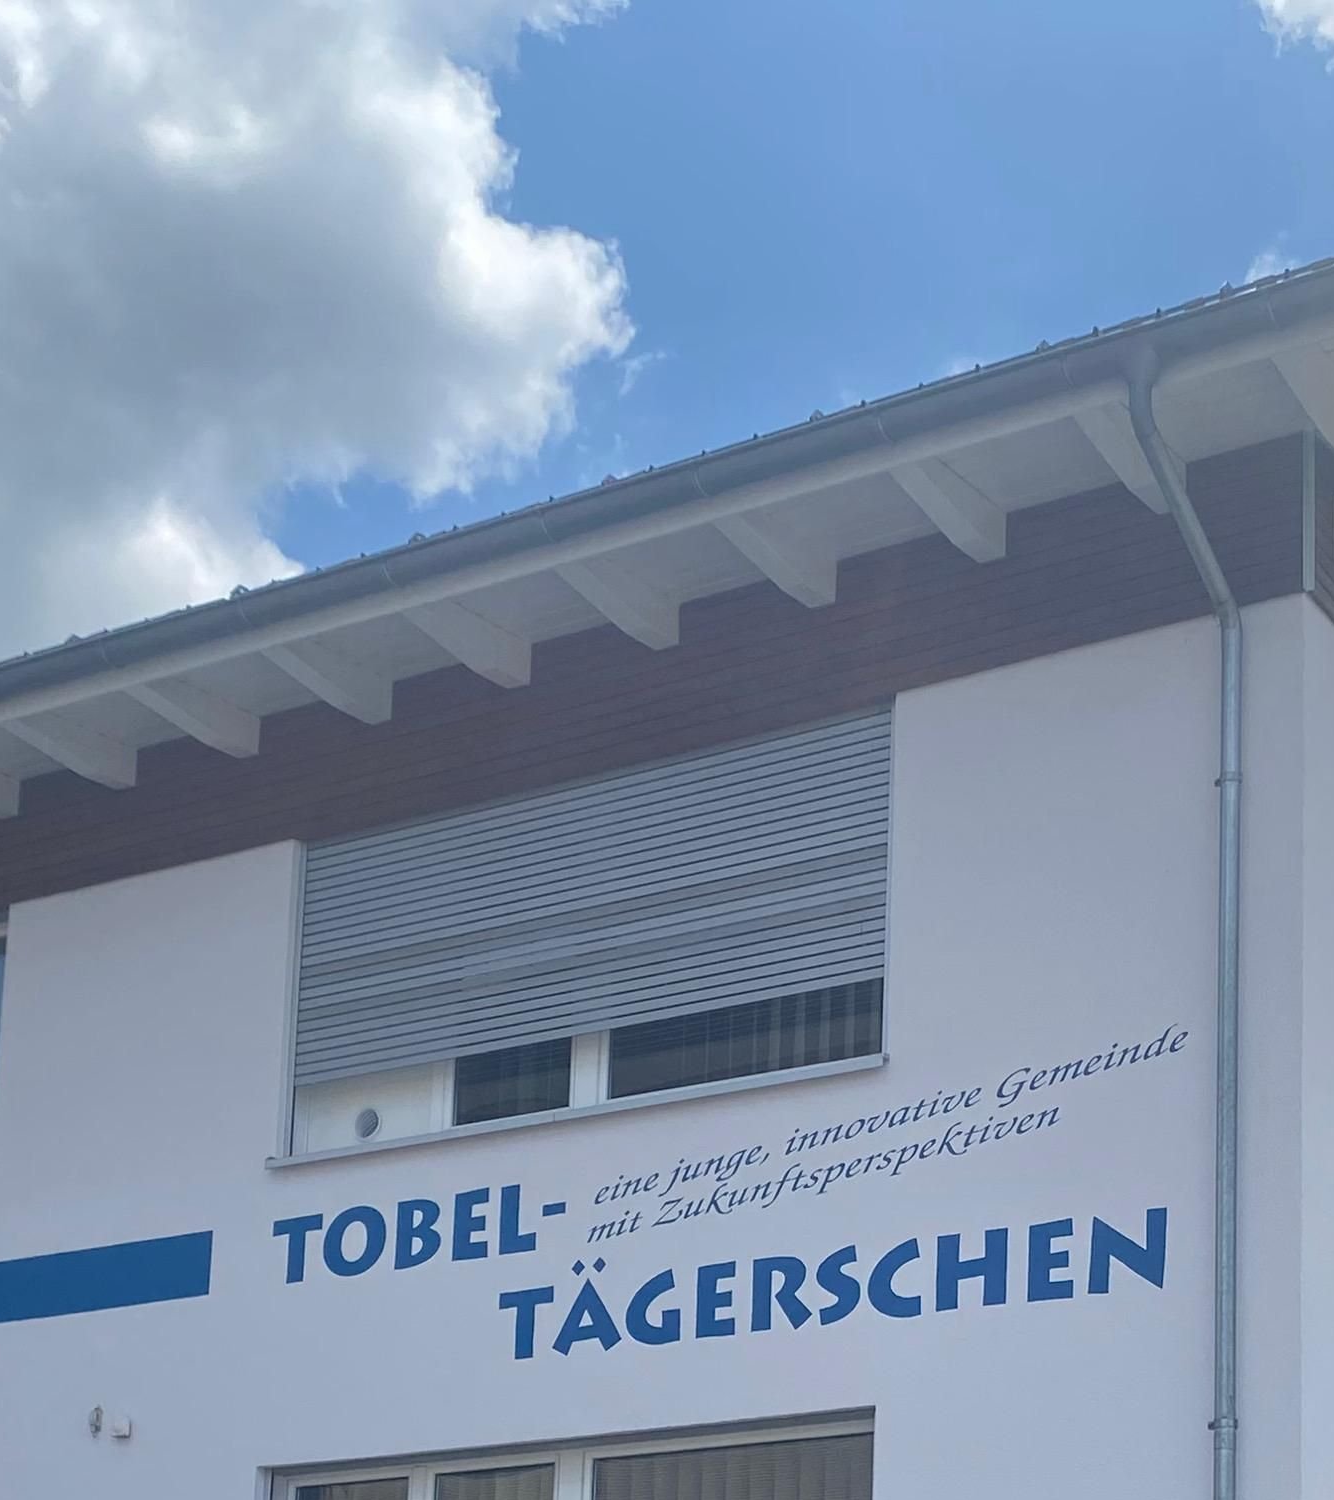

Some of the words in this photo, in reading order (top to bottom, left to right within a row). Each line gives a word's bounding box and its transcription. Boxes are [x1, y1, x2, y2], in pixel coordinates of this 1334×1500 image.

[585, 1209, 644, 1245] mit
[650, 1105, 1061, 1228] Zukunftsperspektiven
[593, 1172, 661, 1206] eine
[657, 1144, 771, 1199] junge,
[784, 1086, 983, 1157] innovative
[994, 1022, 1190, 1109] Gemeinde
[271, 1182, 568, 1286] TOBEL-
[497, 1205, 1169, 1361] TÄGERSCHEN
